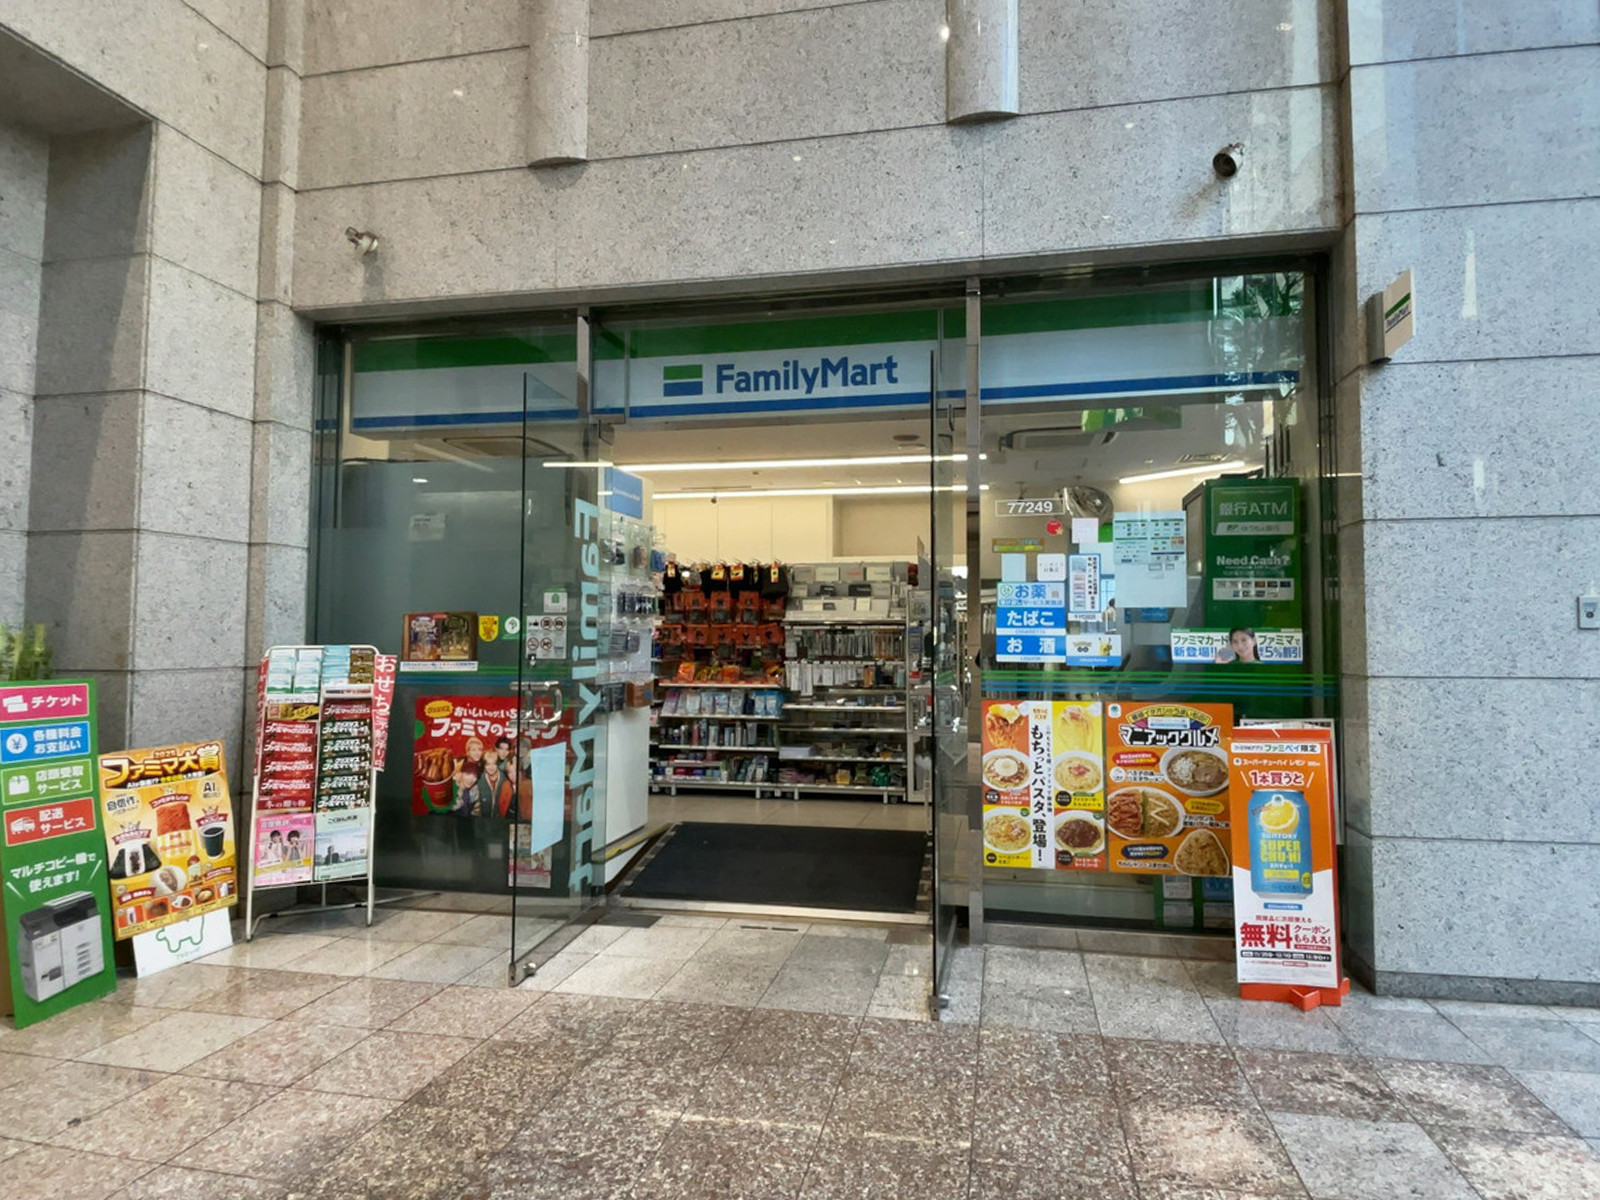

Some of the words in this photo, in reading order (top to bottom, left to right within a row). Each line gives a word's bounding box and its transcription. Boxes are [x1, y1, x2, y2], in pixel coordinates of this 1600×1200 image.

[716, 355, 899, 394] FamilyMart
[1008, 501, 1053, 513] 77249
[1216, 555, 1247, 566] Need
[1006, 610, 1054, 627] たばこ
[1173, 634, 1229, 646] ファミマカード
[31, 693, 82, 709] チケット
[1120, 726, 1219, 747] マニアックグルメ
[101, 744, 219, 788] ファミマ大賞
[1250, 770, 1304, 785] 1本買うと
[37, 779, 82, 795] サービス
[40, 817, 86, 835] サービス
[1240, 922, 1293, 949] 無料
[1294, 925, 1330, 934] クーポン
